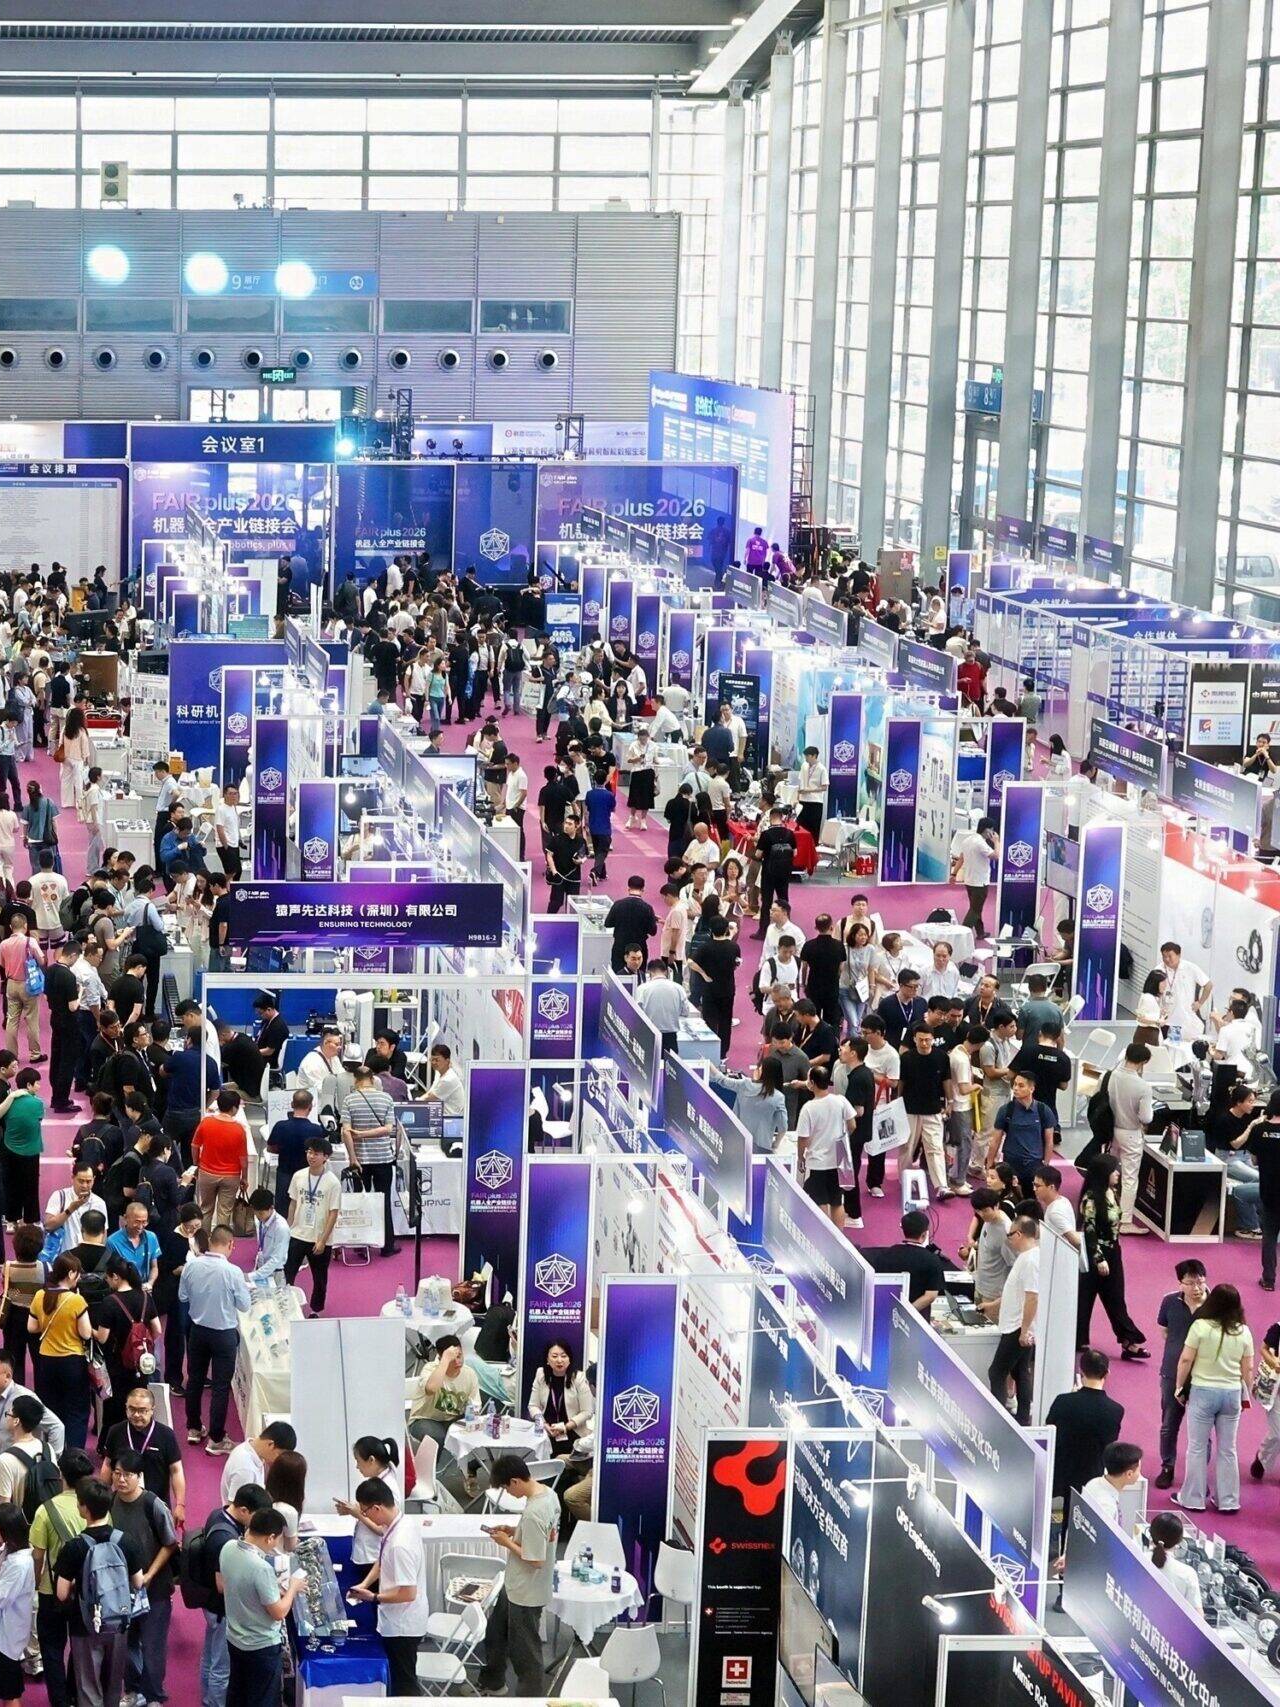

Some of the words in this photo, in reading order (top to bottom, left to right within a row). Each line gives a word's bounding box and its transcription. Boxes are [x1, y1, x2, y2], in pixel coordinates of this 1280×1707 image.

[232, 275, 241, 289] 9
[201, 436, 264, 454] 会议室1
[29, 464, 77, 474] 会议排期
[655, 498, 706, 517] 2026
[153, 517, 297, 535] 机器全产业链接会
[275, 904, 458, 917] 猿声先达科技（深圳）有限公司
[606, 1438, 627, 1446] FAIR
[628, 1438, 645, 1448] plus
[645, 1438, 665, 1446] 2026
